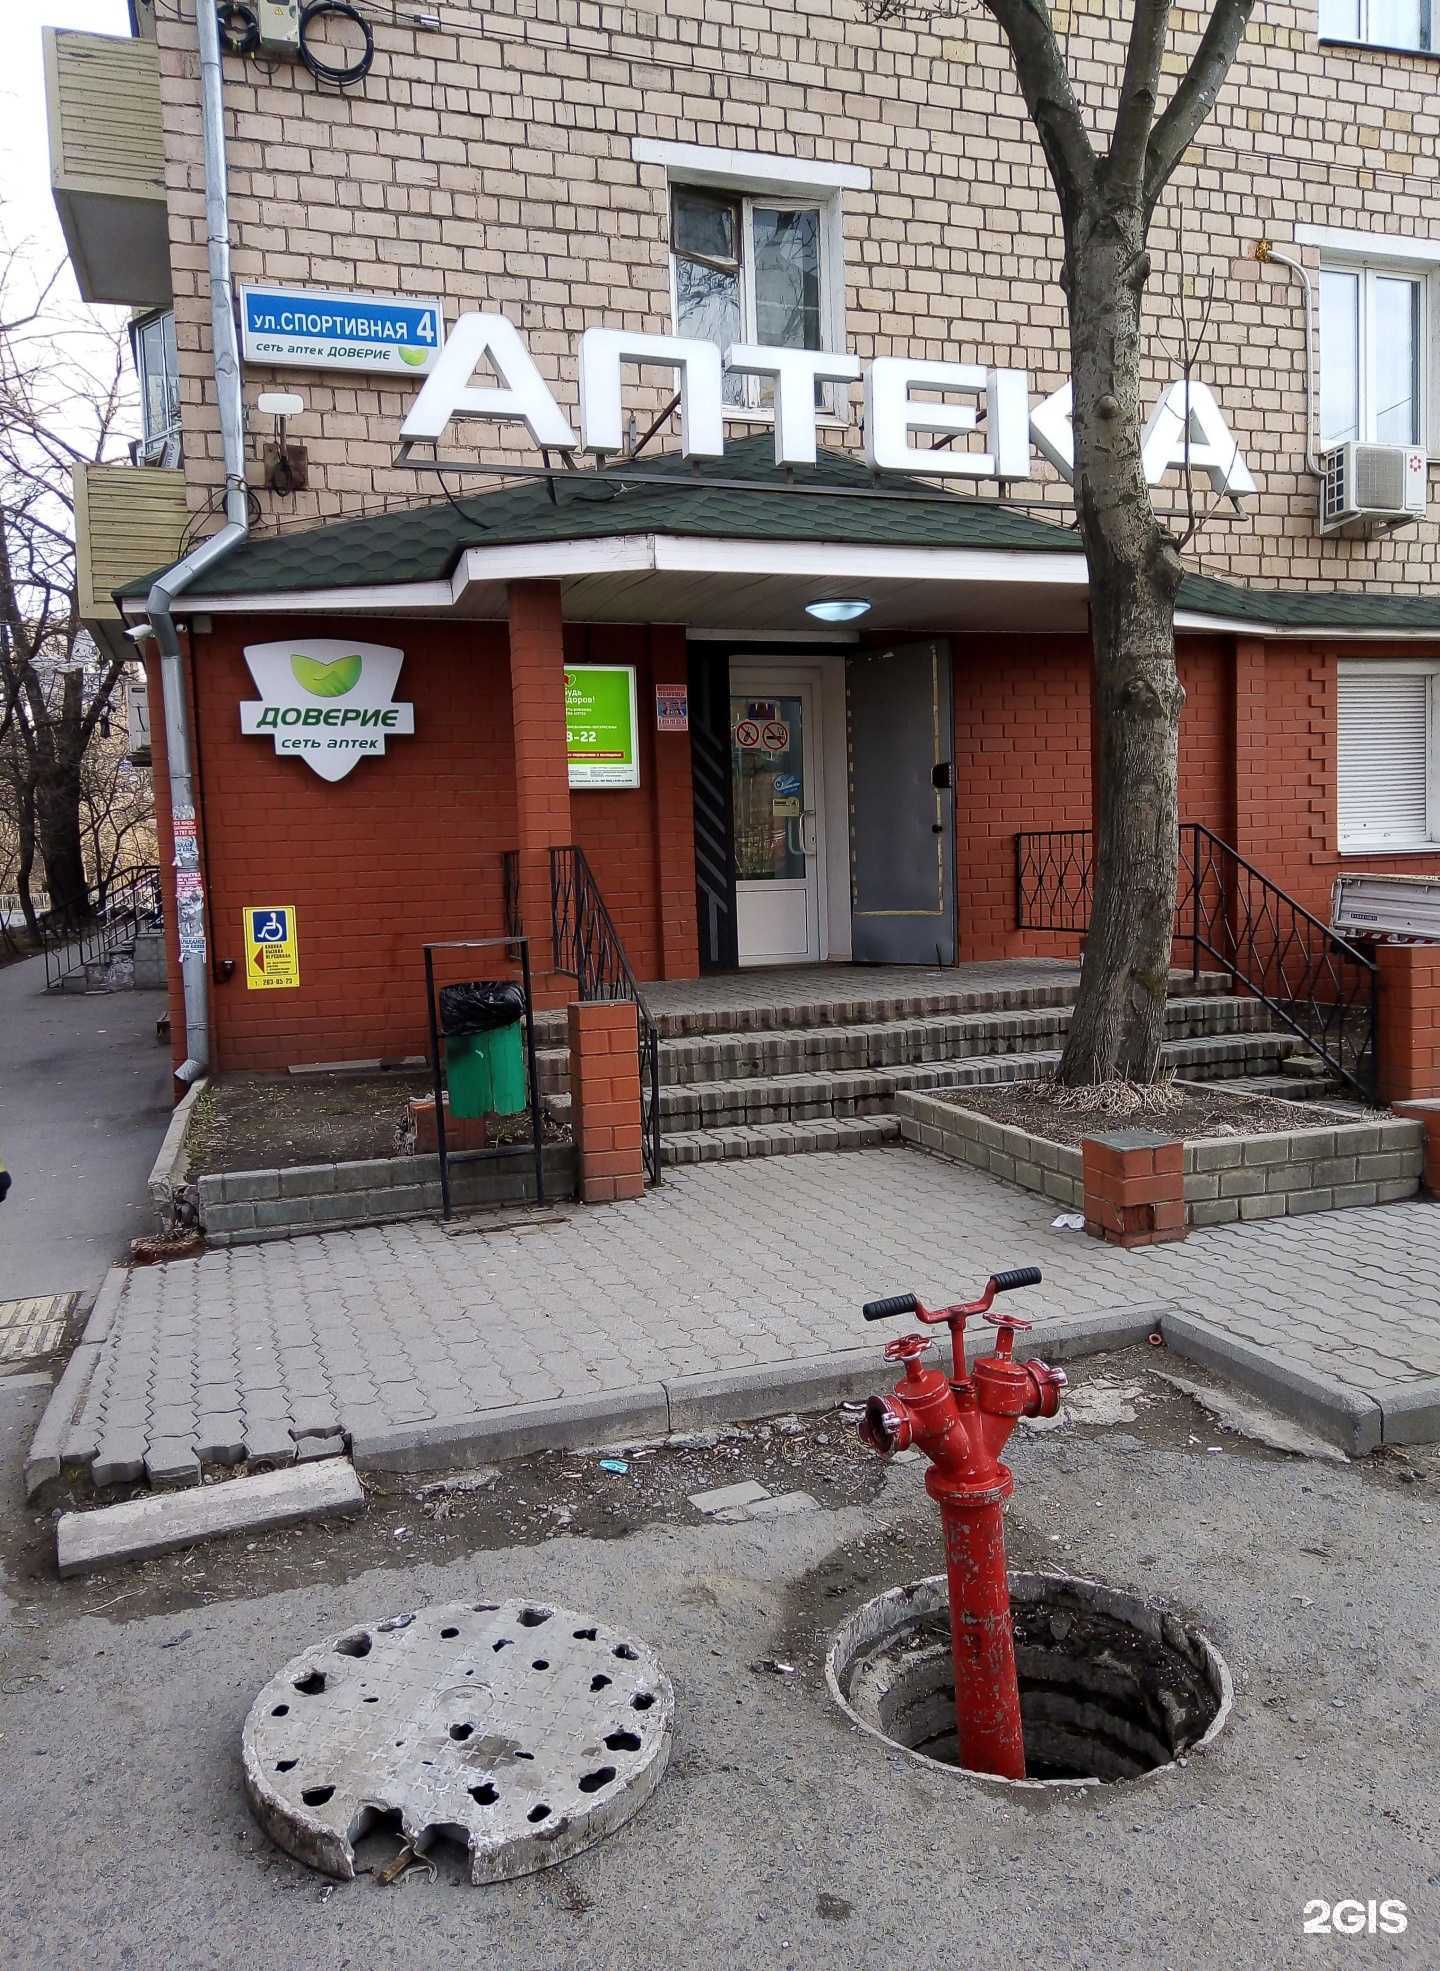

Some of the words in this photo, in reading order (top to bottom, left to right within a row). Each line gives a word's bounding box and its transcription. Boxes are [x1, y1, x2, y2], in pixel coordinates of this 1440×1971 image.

[253, 312, 408, 340] ул.СПОРТИВНАЯ
[416, 311, 435, 343] 4
[255, 343, 284, 352] сеть
[287, 344, 324, 356] аптек
[327, 346, 391, 360] ДОВЕРИЕ
[399, 312, 1259, 498] АПТЕКА
[256, 707, 399, 729] ДОВЕРИЕ
[281, 738, 321, 749] сеть
[327, 738, 379, 749] аптек
